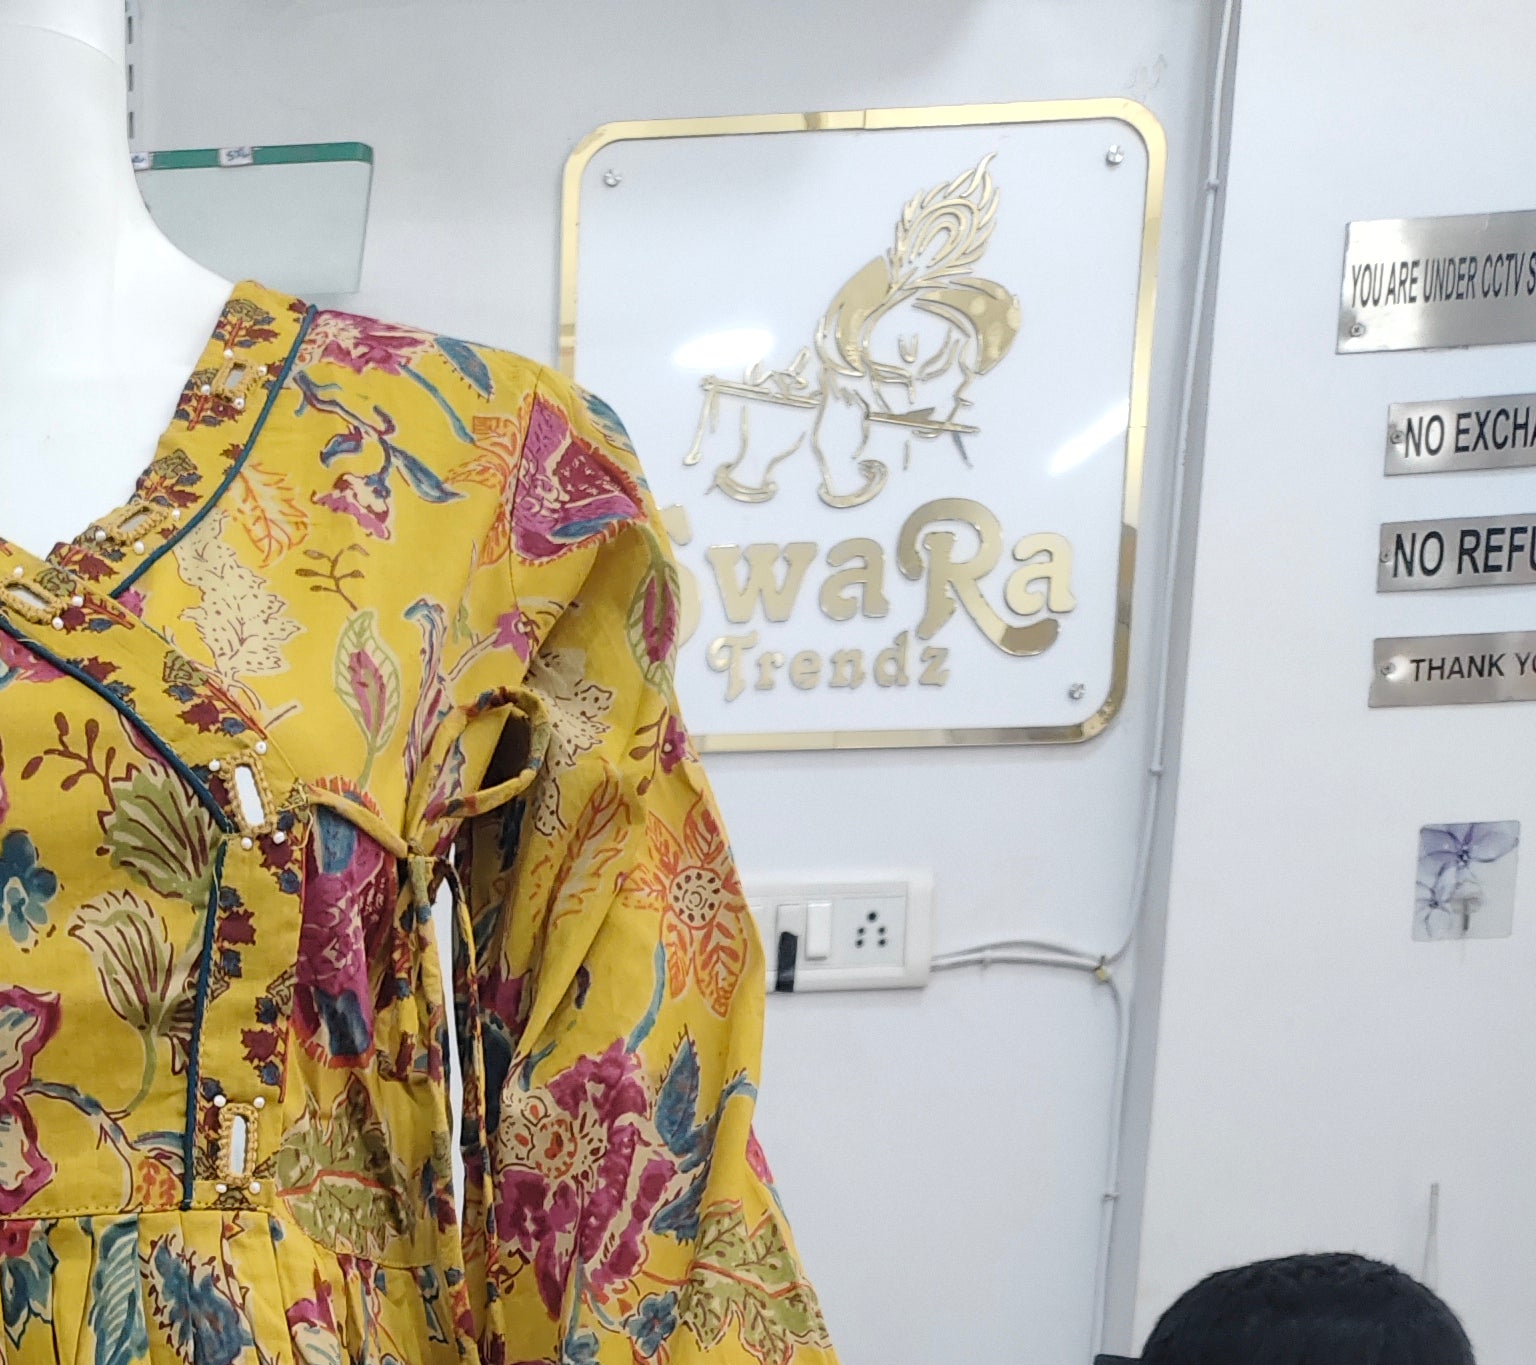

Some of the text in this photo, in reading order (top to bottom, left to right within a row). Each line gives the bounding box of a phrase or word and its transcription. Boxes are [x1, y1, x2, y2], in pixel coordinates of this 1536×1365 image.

[1351, 262, 1385, 309] YOU
[1385, 259, 1421, 306] ARE
[1423, 255, 1478, 304] UNDER
[1481, 251, 1526, 300] CCTV
[1404, 414, 1445, 458] NO
[1392, 530, 1445, 578] NO
[705, 629, 951, 702] Trendz
[1409, 652, 1506, 682] THANK
